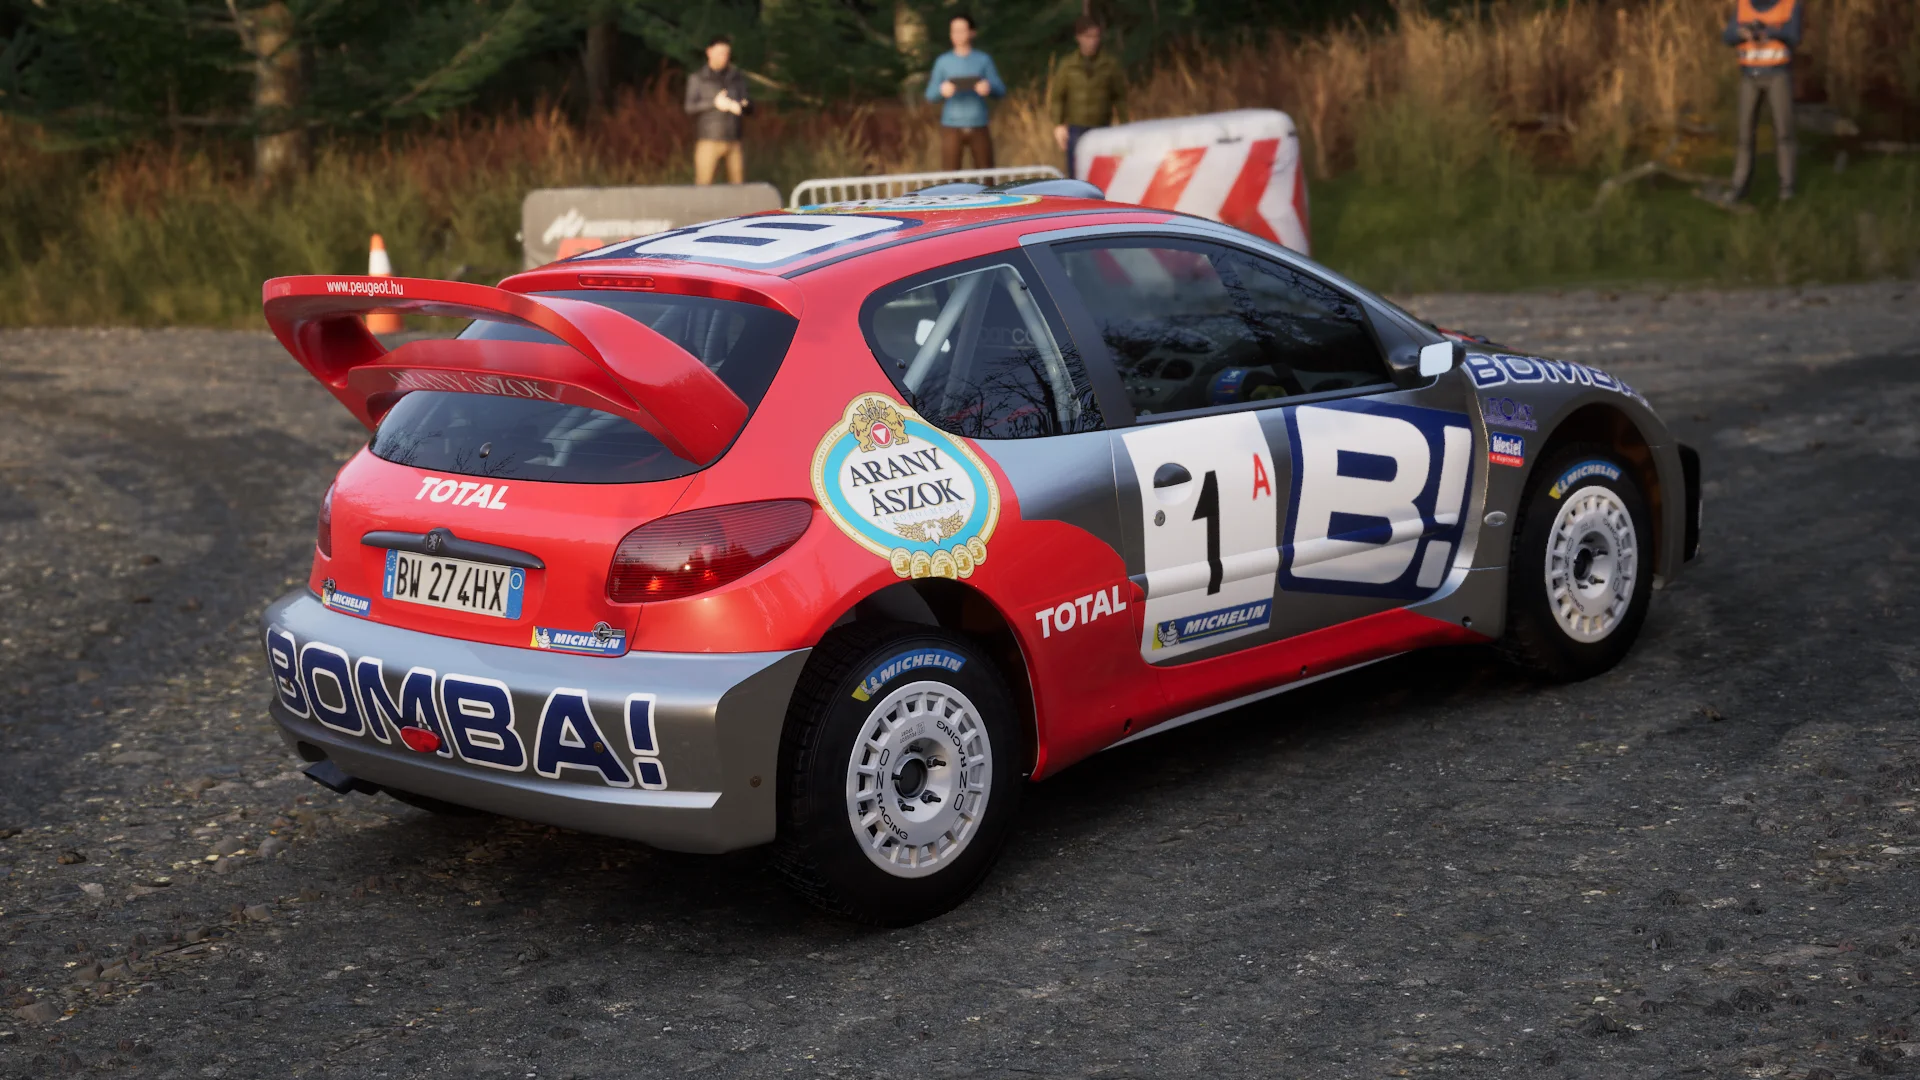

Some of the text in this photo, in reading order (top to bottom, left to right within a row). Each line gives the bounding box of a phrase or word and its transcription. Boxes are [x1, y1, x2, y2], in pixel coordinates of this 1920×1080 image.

[326, 280, 404, 296] www.peugeot.hu
[388, 371, 560, 401] ARANY ÁSZOK
[850, 447, 945, 487] ARANY
[1252, 453, 1272, 500] A
[1567, 464, 1620, 485] MICHELIN
[414, 476, 509, 510] TOTAL
[869, 478, 967, 517] ÁSZOK
[1290, 405, 1472, 588] B!
[1192, 470, 1223, 596] 1
[332, 593, 369, 611] MICHELIN
[396, 556, 422, 598] BW
[428, 562, 506, 612] 274HX
[1036, 585, 1127, 639] TOTAL
[1184, 604, 1267, 635] MICHELIN
[880, 653, 963, 683] MICHELIN
[266, 623, 667, 791] BOMBA!
[936, 720, 968, 768] RACING
[876, 792, 909, 841] RACING
